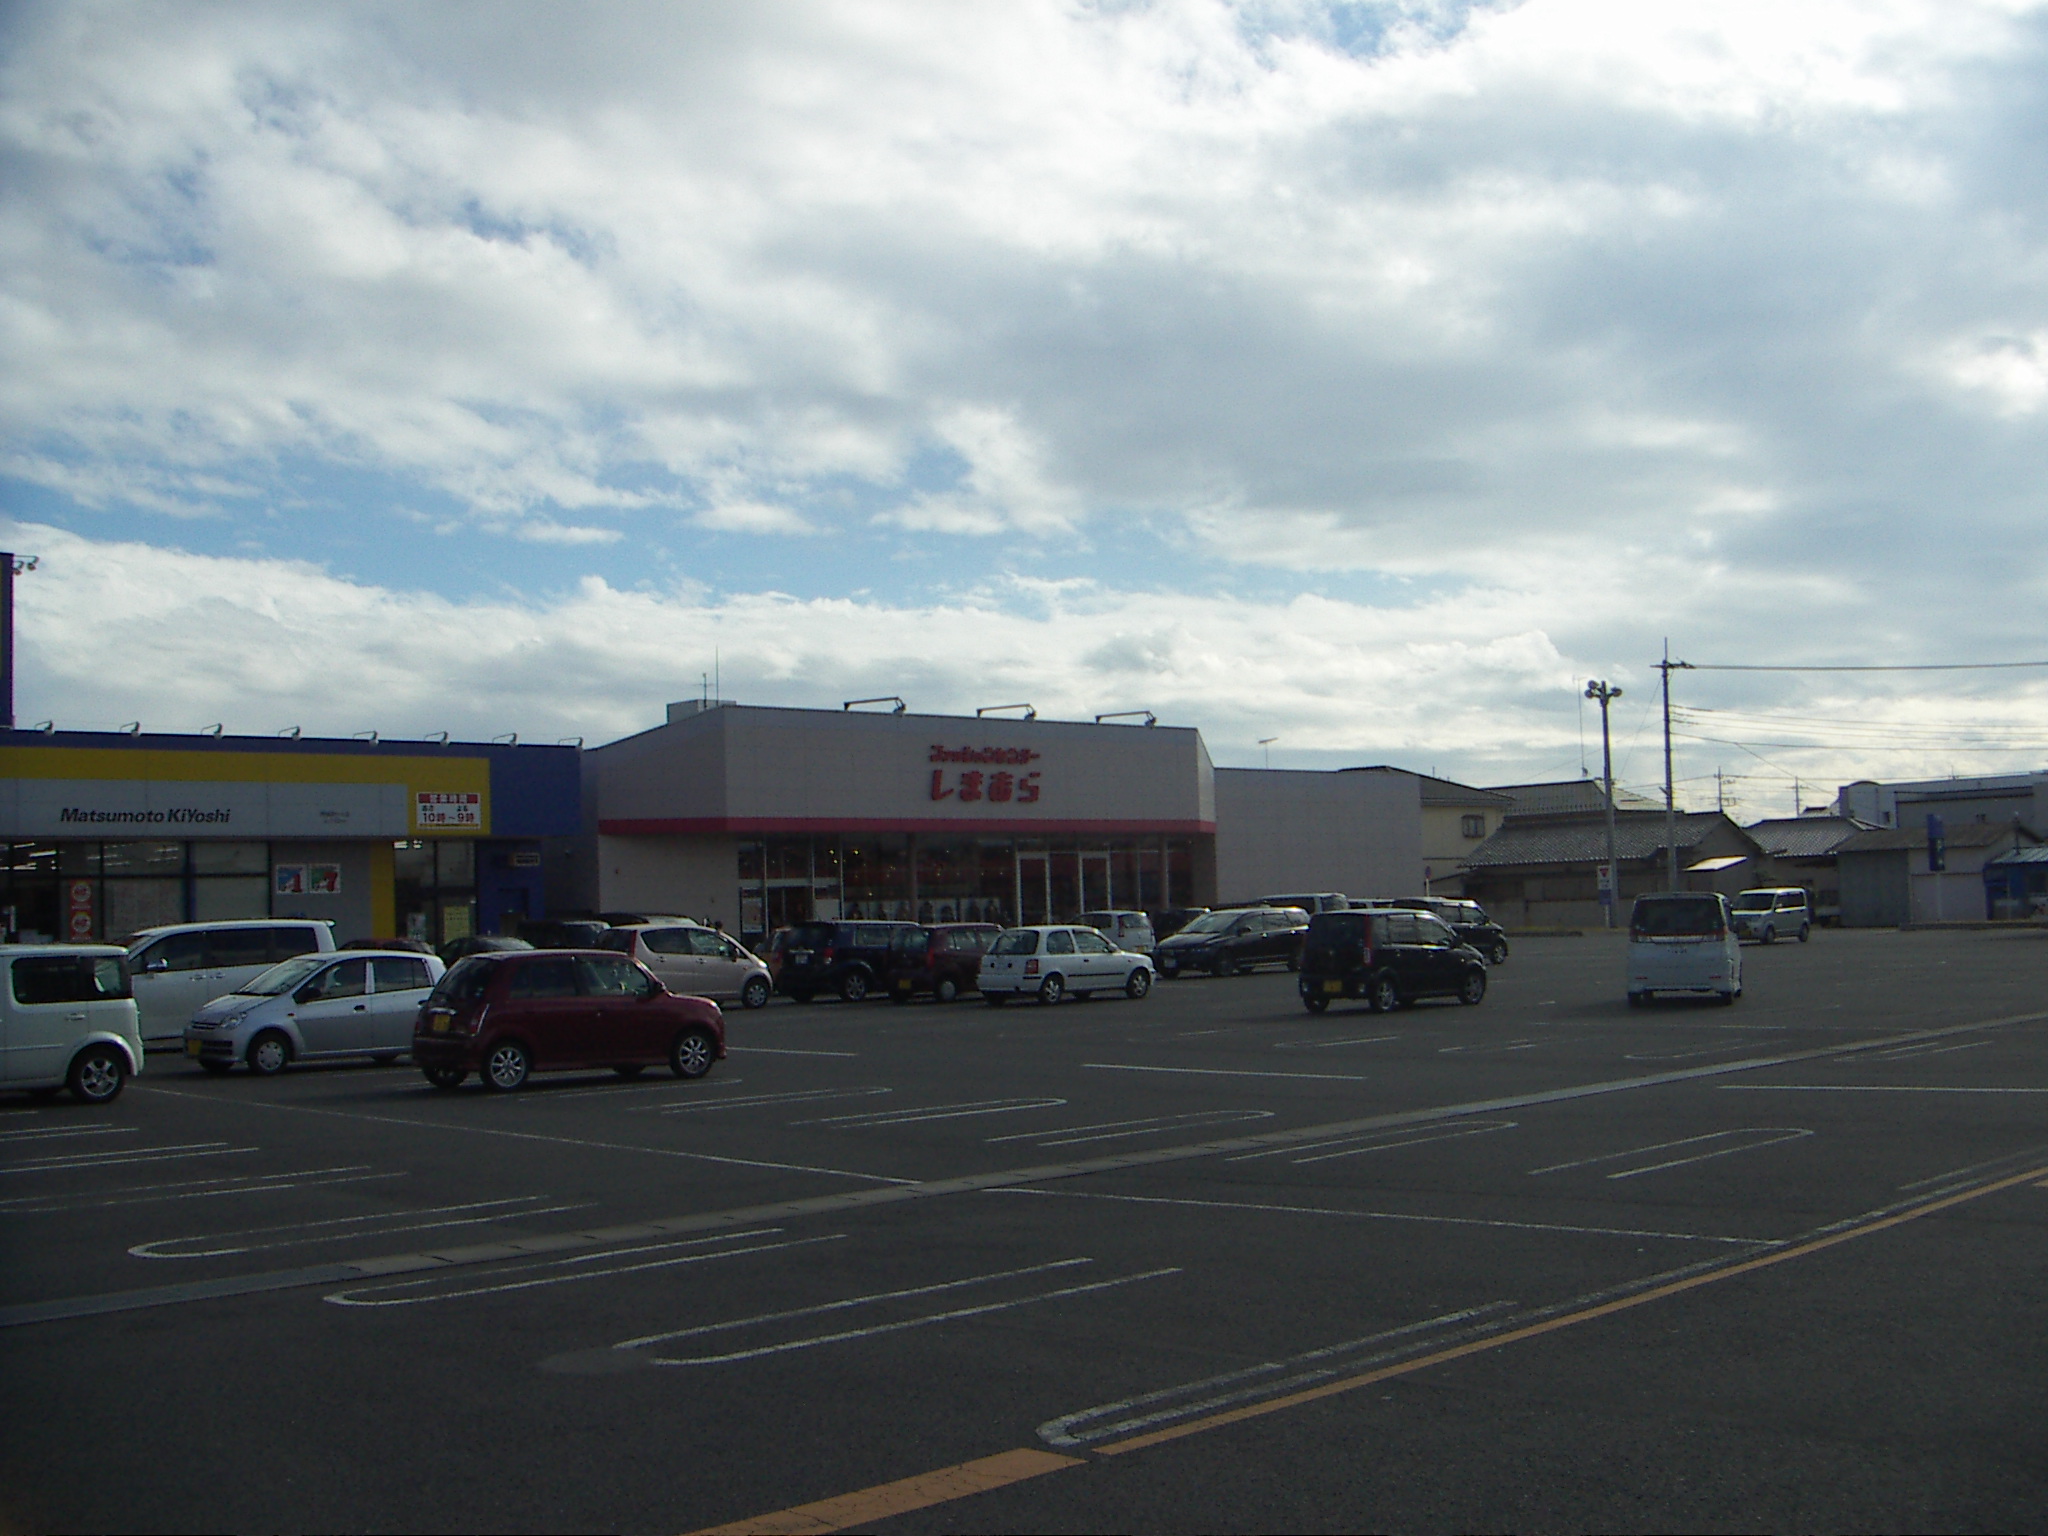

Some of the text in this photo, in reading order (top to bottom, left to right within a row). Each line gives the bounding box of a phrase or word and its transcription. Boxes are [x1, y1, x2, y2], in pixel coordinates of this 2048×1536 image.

[931, 770, 1041, 802] しまむら
[60, 808, 231, 823] Matsumoto KiYoshi
